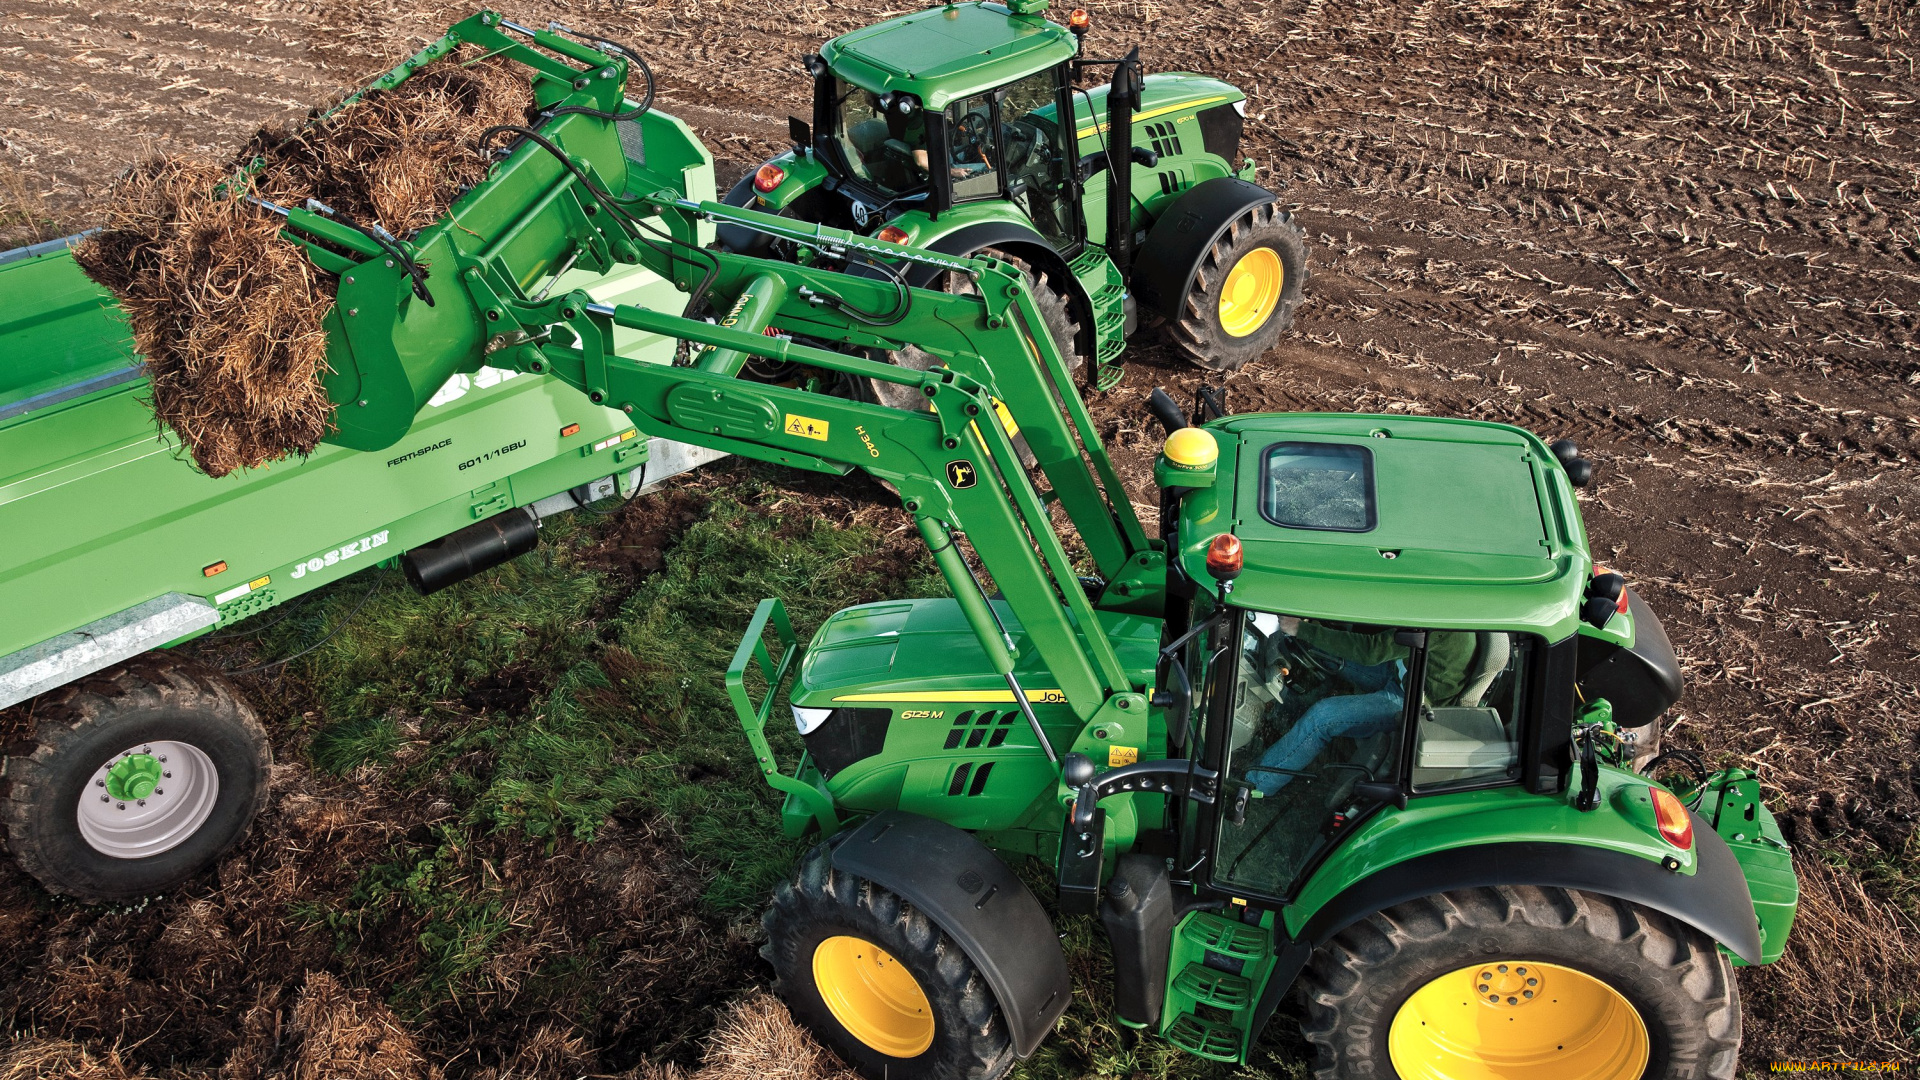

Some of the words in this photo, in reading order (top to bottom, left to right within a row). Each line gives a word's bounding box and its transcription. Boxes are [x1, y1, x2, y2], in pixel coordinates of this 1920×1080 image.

[387, 438, 453, 468] FERTI-SPACE
[458, 439, 527, 471] 6011/16BU
[855, 425, 866, 436] H
[861, 434, 880, 458] 340
[290, 530, 390, 579] JOSKIN
[1040, 692, 1068, 703] JOH
[901, 710, 930, 720] 6125
[930, 710, 945, 720] M
